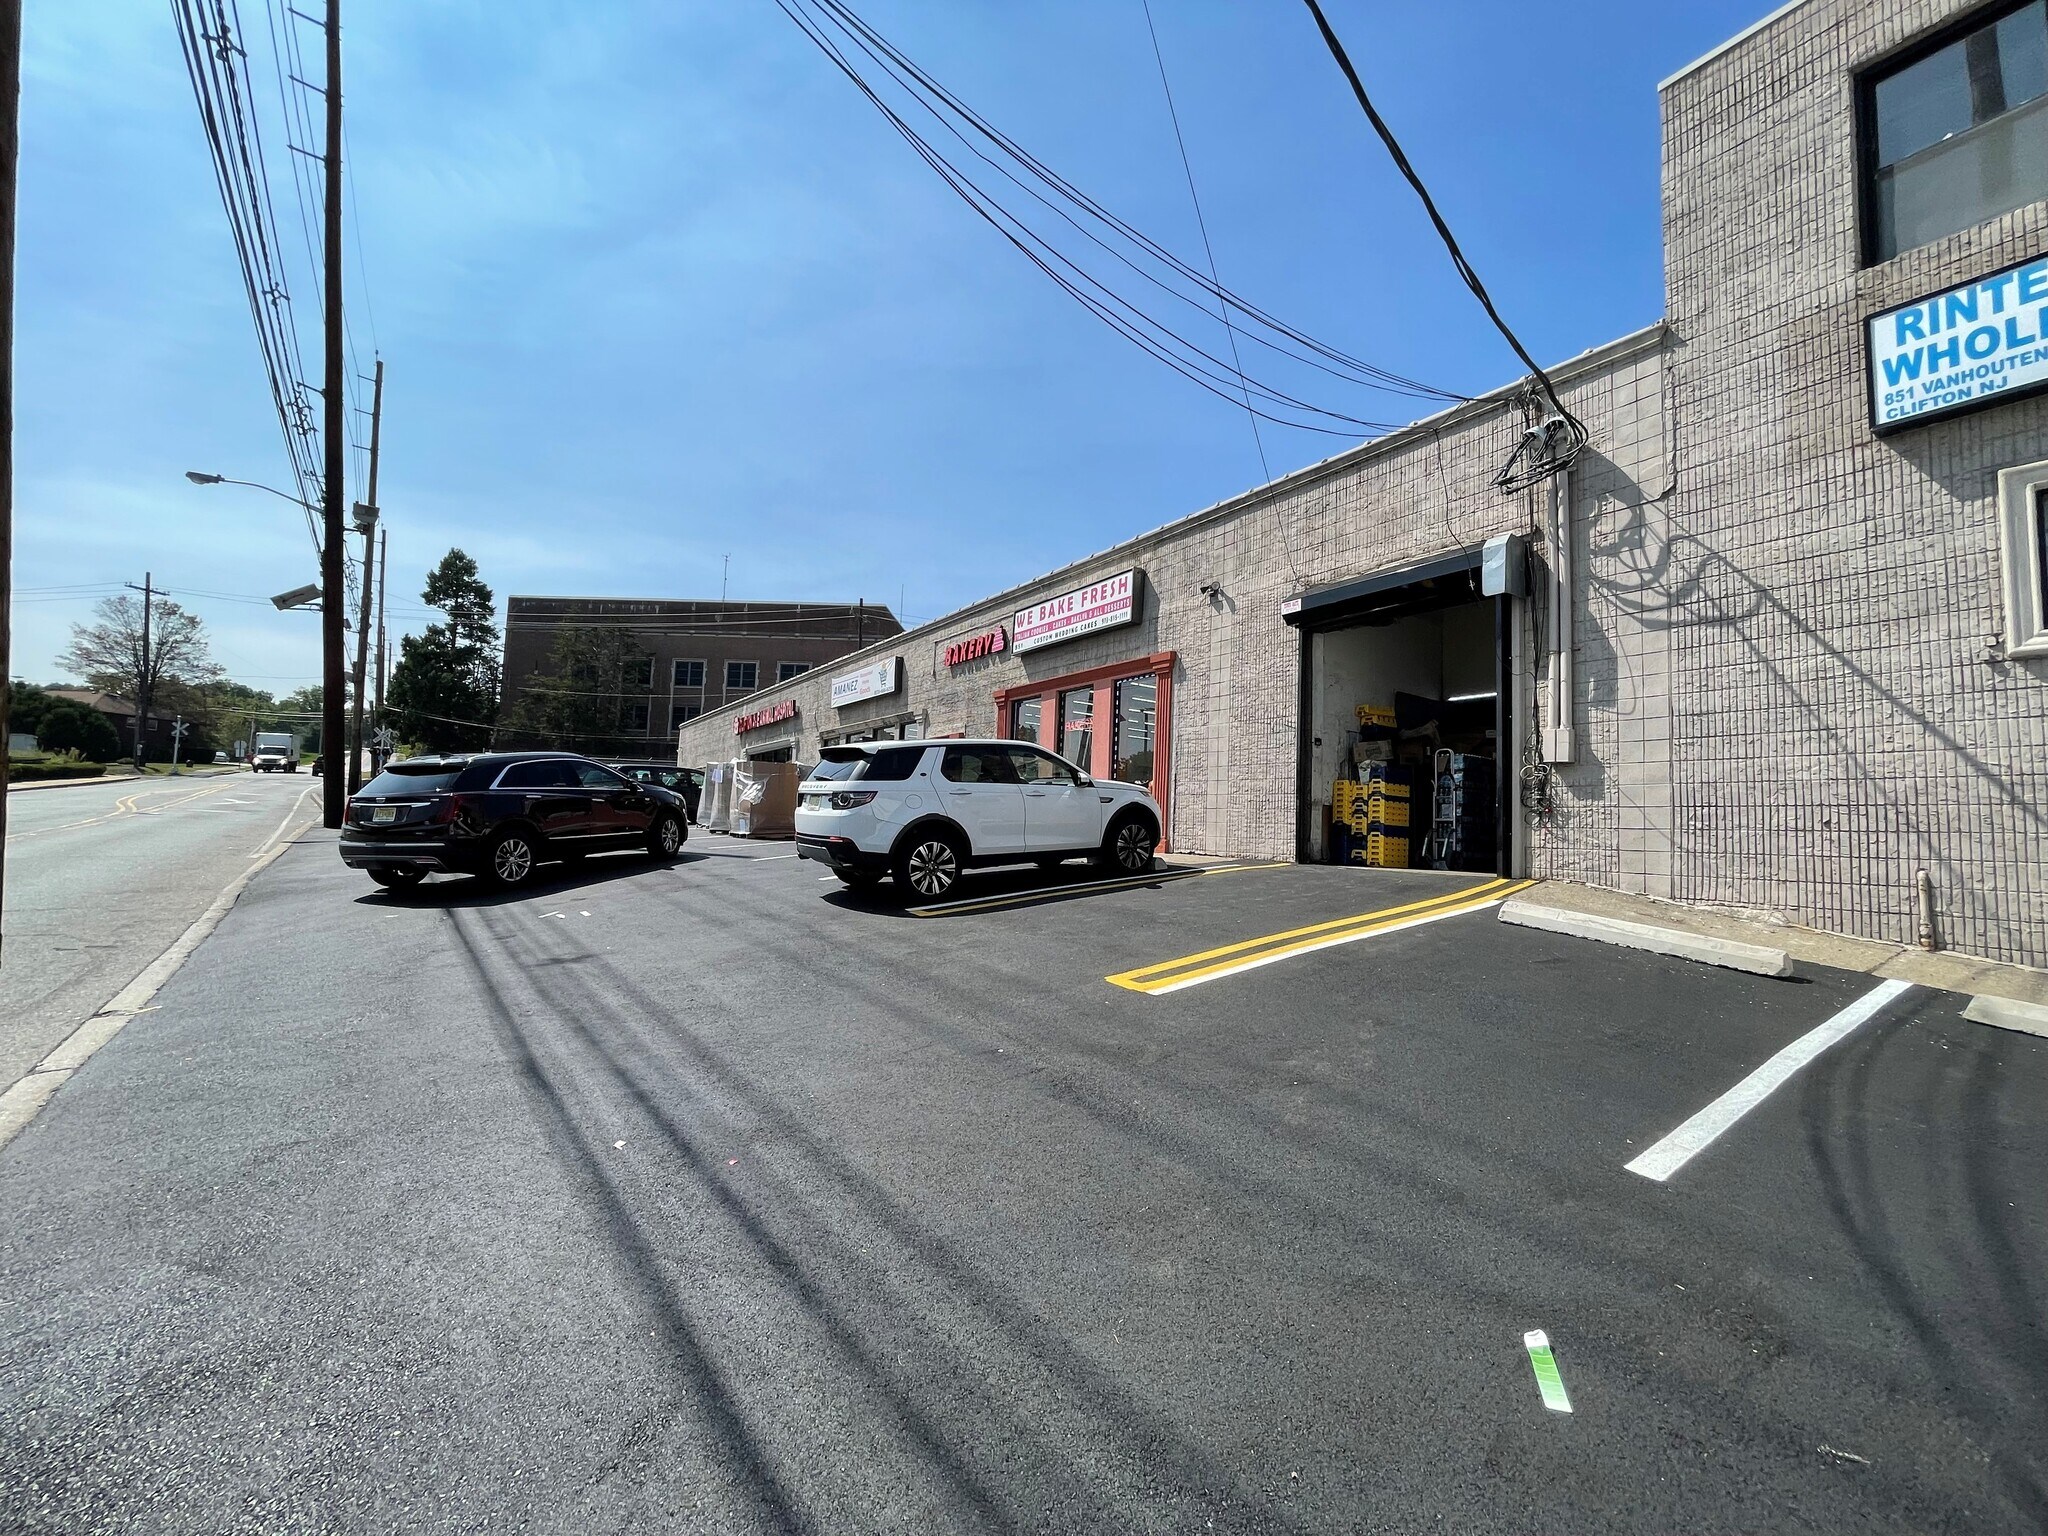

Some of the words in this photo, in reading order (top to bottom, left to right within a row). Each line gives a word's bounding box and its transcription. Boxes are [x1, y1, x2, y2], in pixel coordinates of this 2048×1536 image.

[1884, 386, 1915, 406] 851
[1921, 346, 2048, 395] VANHOUTEN
[1886, 386, 1973, 420] CLIFTON
[1979, 375, 2008, 394] NJ
[1016, 610, 1033, 628] WE
[1039, 596, 1074, 622] BAKE
[1081, 576, 1128, 608] FRESH
[1094, 607, 1103, 617] ALL
[1104, 598, 1130, 614] DESSERTS
[944, 633, 993, 667] BAKERY
[1033, 634, 1053, 645] CUSTOM
[1054, 626, 1079, 638] WEDDING
[1080, 620, 1098, 631] CAKES
